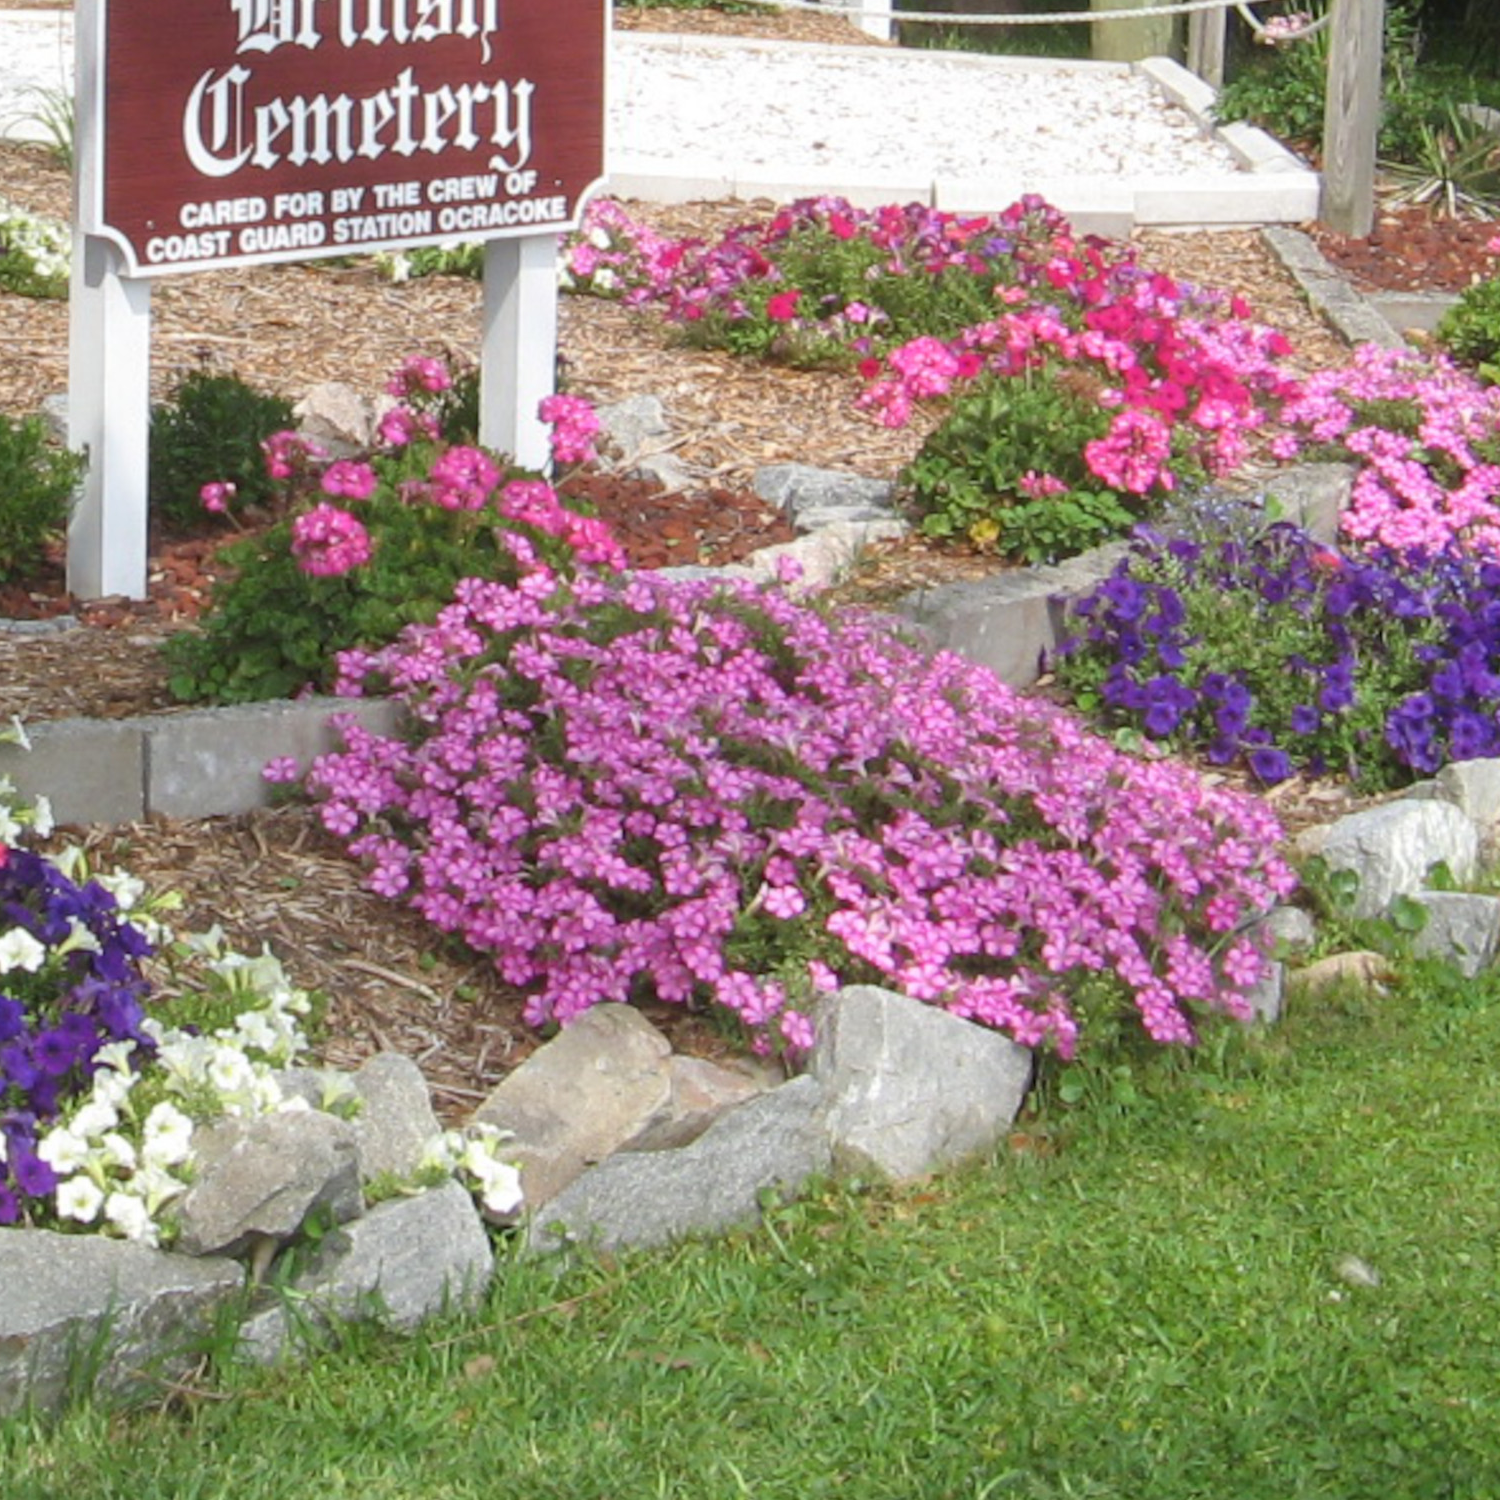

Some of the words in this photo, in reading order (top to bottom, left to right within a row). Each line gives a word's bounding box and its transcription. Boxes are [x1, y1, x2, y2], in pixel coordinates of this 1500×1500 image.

[183, 63, 535, 177] Cemetery
[146, 230, 233, 263] COAST
[238, 221, 326, 253] GUARD
[333, 210, 432, 243] STATION
[439, 196, 567, 231] OCRACOKE
[179, 198, 267, 229] CARED
[274, 192, 324, 219] FOR
[331, 187, 364, 213] BY
[373, 182, 420, 209] THE
[427, 175, 498, 205] CREW
[505, 170, 538, 195] OF
